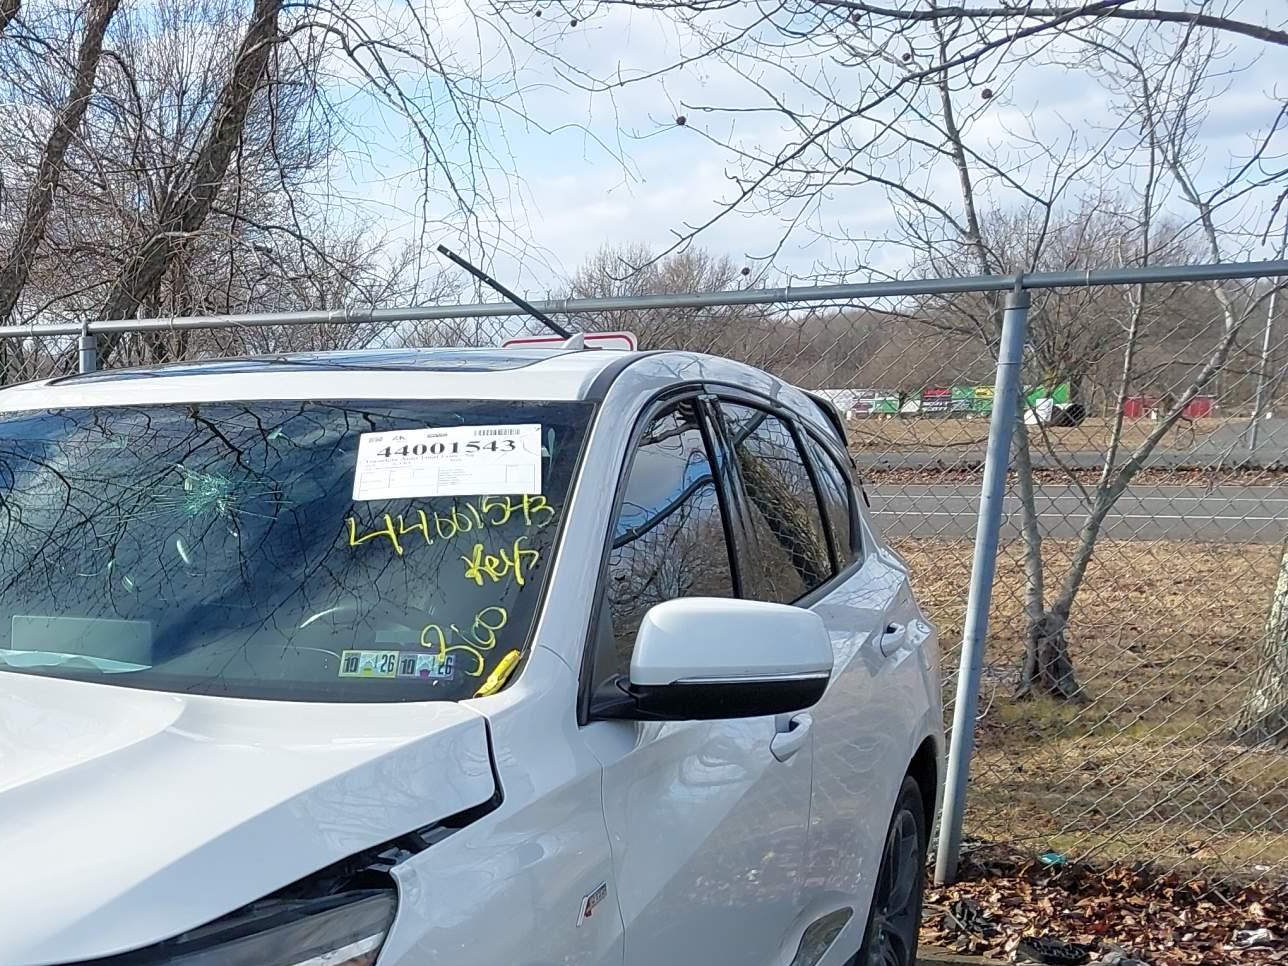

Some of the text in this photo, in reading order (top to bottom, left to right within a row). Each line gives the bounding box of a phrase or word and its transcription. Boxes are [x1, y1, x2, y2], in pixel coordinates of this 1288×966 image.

[376, 439, 516, 458] 44001543
[344, 654, 396, 673] 10 26
[401, 658, 416, 675] 10
